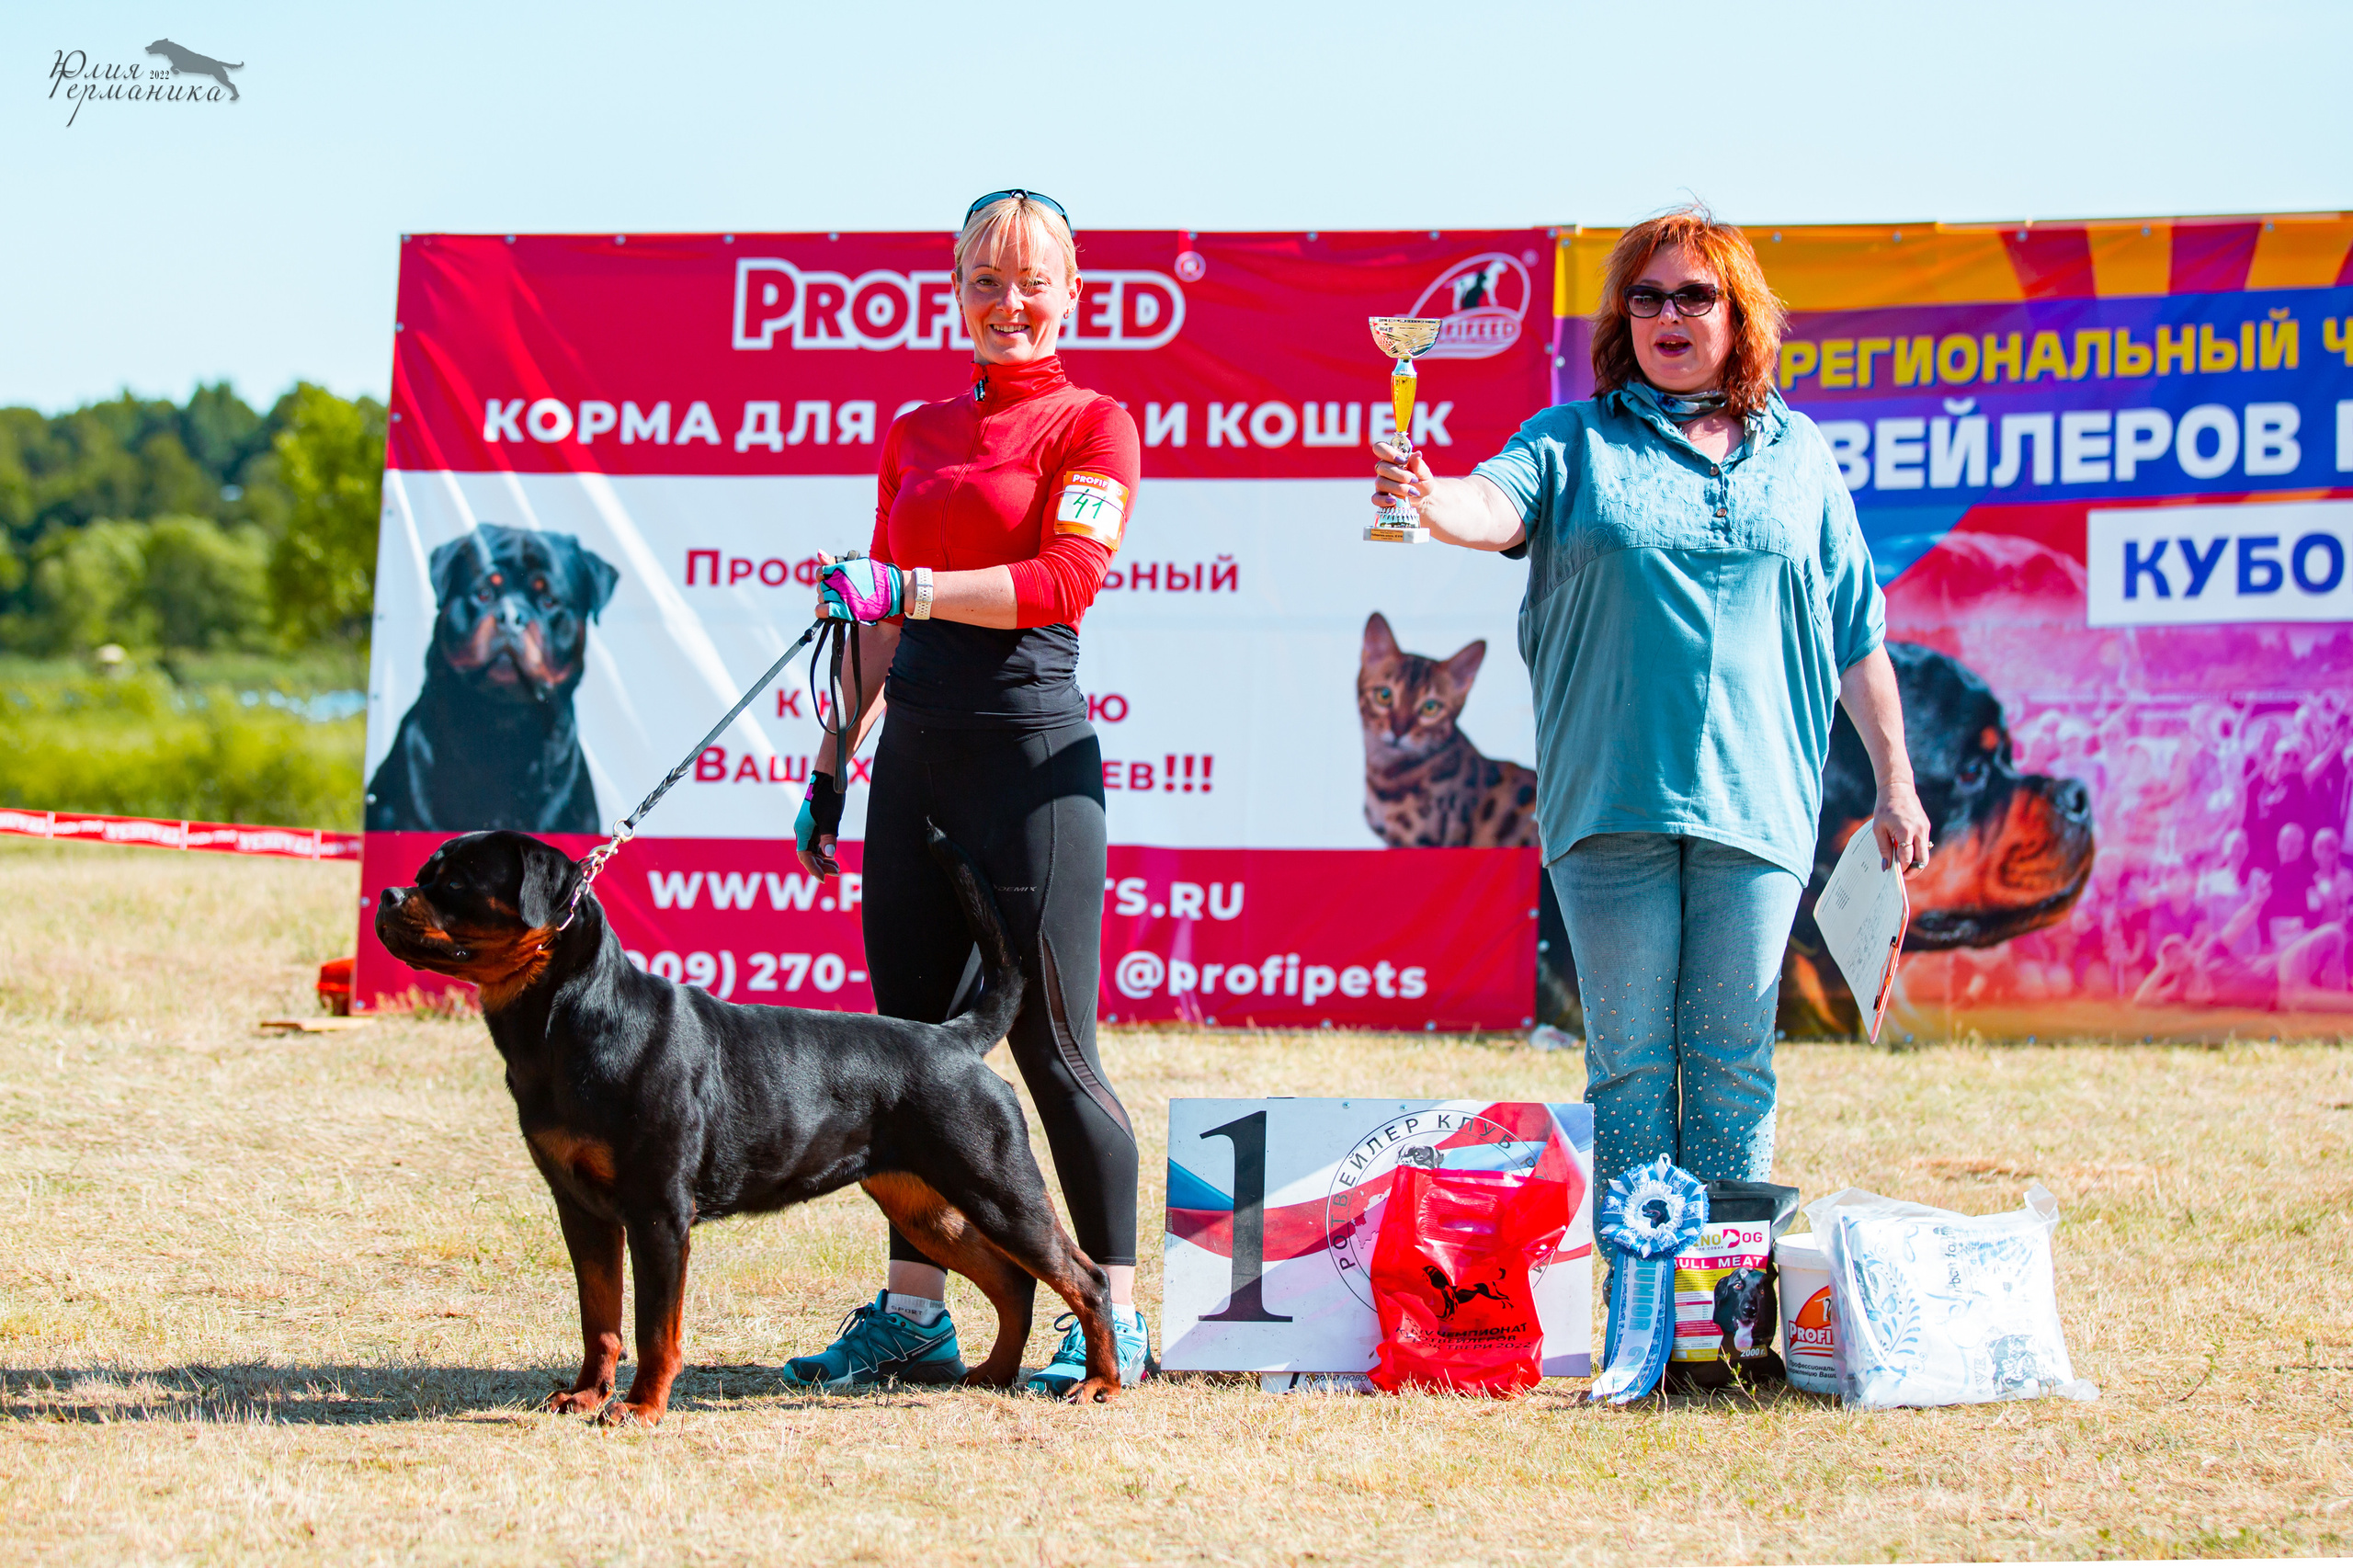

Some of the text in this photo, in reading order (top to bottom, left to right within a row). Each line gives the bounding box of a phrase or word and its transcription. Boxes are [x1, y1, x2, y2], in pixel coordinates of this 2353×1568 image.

[733, 257, 1187, 352] PROFED
[1779, 308, 2299, 390] РЕГИОНАЛЬНЫЙ
[483, 397, 722, 446] КОРМА
[734, 401, 877, 452] ДЛЯ
[1144, 402, 1188, 448] И
[1817, 397, 2300, 492] ВЕЙЛЕРОВ
[2121, 531, 2353, 600] КУБО
[1115, 950, 1427, 1006] @profipets
[1199, 1109, 1293, 1323] 1
[1331, 1114, 1515, 1271] РОТВЕЙЛЕР КЛУБ
[1718, 1256, 1764, 1268] MEAT
[891, 1305, 923, 1316] SPORT
[1629, 1260, 1657, 1332] JUNIOR
[1437, 1324, 1527, 1337] ЧЕМПИОНАТ
[1740, 1348, 1759, 1358] 2000
[1789, 1320, 1833, 1346] PROFI
[1790, 1360, 1836, 1371] Профессиональ
[1819, 1370, 1837, 1379] Ваш
